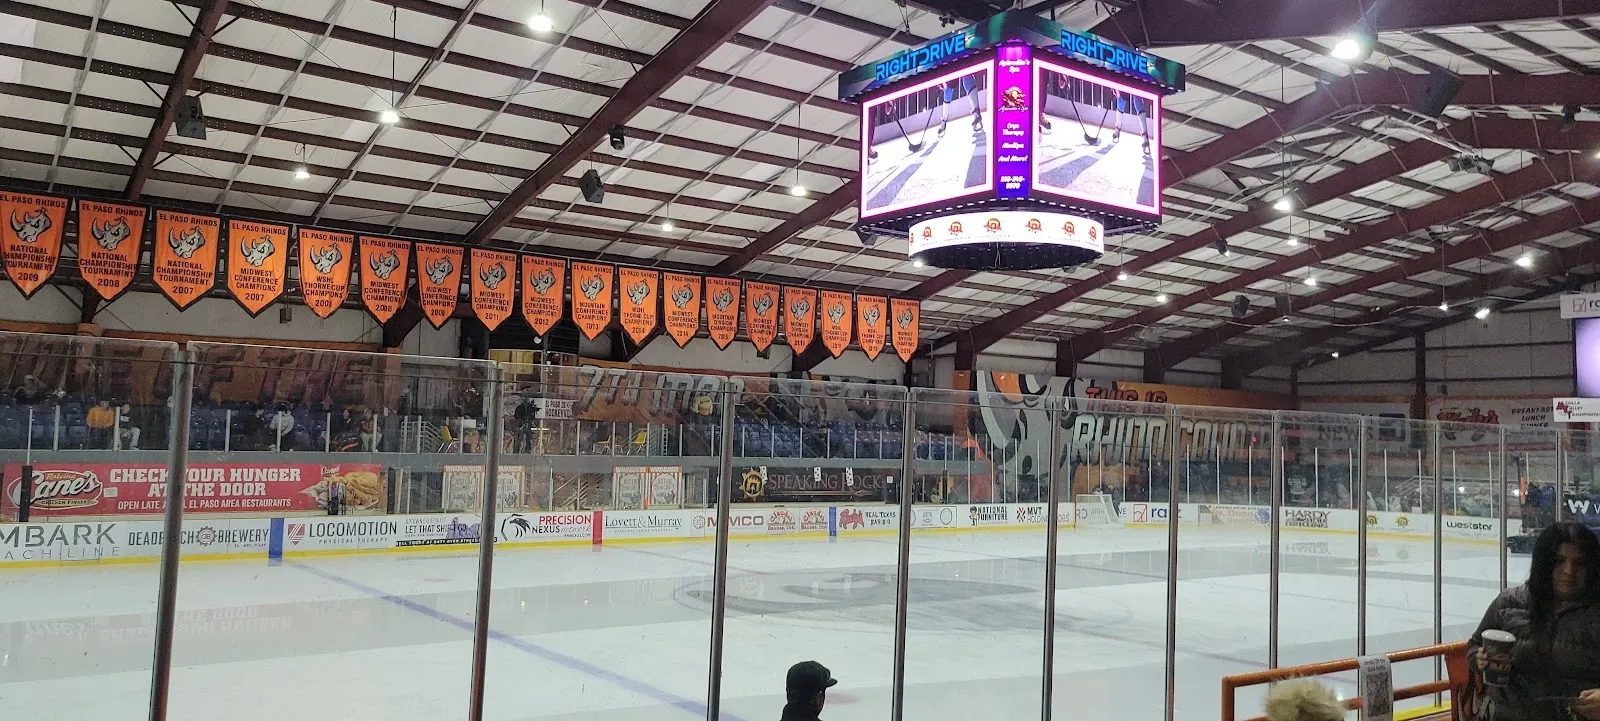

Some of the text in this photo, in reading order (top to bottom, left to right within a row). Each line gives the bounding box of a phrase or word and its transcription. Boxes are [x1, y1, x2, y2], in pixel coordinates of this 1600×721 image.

[876, 33, 966, 81] RIGHTDRIVE
[1061, 30, 1148, 75] RIGHTDRIVE
[12, 196, 33, 205] PASO
[35, 199, 66, 208] RHINOS
[93, 204, 113, 213] PASO
[115, 208, 144, 217] RHINOS
[170, 216, 189, 224] PASO
[190, 218, 218, 226] RHINOS
[242, 224, 259, 232] PASO
[261, 227, 287, 236] RHINOS
[10, 244, 48, 255] NATIONAL
[388, 242, 410, 250] RHINOS
[92, 252, 128, 262] NATIONAL
[441, 248, 463, 256] RHINOS
[167, 260, 204, 270] NATIONAL
[83, 266, 134, 278] TOURNAMENT
[156, 266, 213, 279] CHAMPIONSHIP
[240, 268, 273, 278] MIDWEST
[98, 278, 120, 288] 2008
[160, 274, 209, 286] TOURNAMENT
[234, 274, 279, 286] CONFERENCE
[370, 280, 400, 290] MIDWEST
[172, 286, 194, 295] 2007
[236, 282, 276, 292] CHAMPIONS
[304, 282, 345, 292] THORNE CUP
[426, 286, 452, 294] MIDWEST
[244, 292, 265, 302] 2007
[306, 290, 344, 299] CHAMPIONS
[364, 288, 404, 297] CONFERENCE
[422, 292, 456, 302] CONFERENCE
[480, 290, 505, 299] MIDWEST
[376, 304, 392, 312] 2008
[422, 299, 454, 308] CHAMPIONS
[484, 312, 499, 321] 2011
[534, 317, 549, 326] 2012
[1085, 387, 1168, 415] THIS IS
[1070, 412, 1167, 467] RHINO
[46, 472, 77, 481] Raising
[185, 468, 227, 482] OUR
[230, 468, 301, 482] HUNGER
[13, 470, 101, 507] Cane's
[219, 482, 268, 497] DOOR
[118, 500, 140, 510] OPEN
[141, 500, 160, 510] LATE
[189, 500, 199, 508] EL
[200, 499, 220, 508] PASO
[221, 499, 240, 508] AREA
[242, 498, 292, 508] RESTAURANTS
[978, 506, 1008, 514] NATIONAL
[1027, 507, 1042, 515] MVT
[1285, 509, 1332, 520] HARDY
[539, 514, 592, 525] PRECISION
[605, 515, 683, 528] Lovett & Murray
[707, 516, 764, 528] MMCO
[309, 520, 397, 538] LOCOMOTION
[406, 525, 414, 534] LET
[419, 524, 434, 534] THAT
[532, 525, 560, 534] NEXUS
[1446, 520, 1493, 531] weststar
[218, 528, 270, 544] BREWERY
